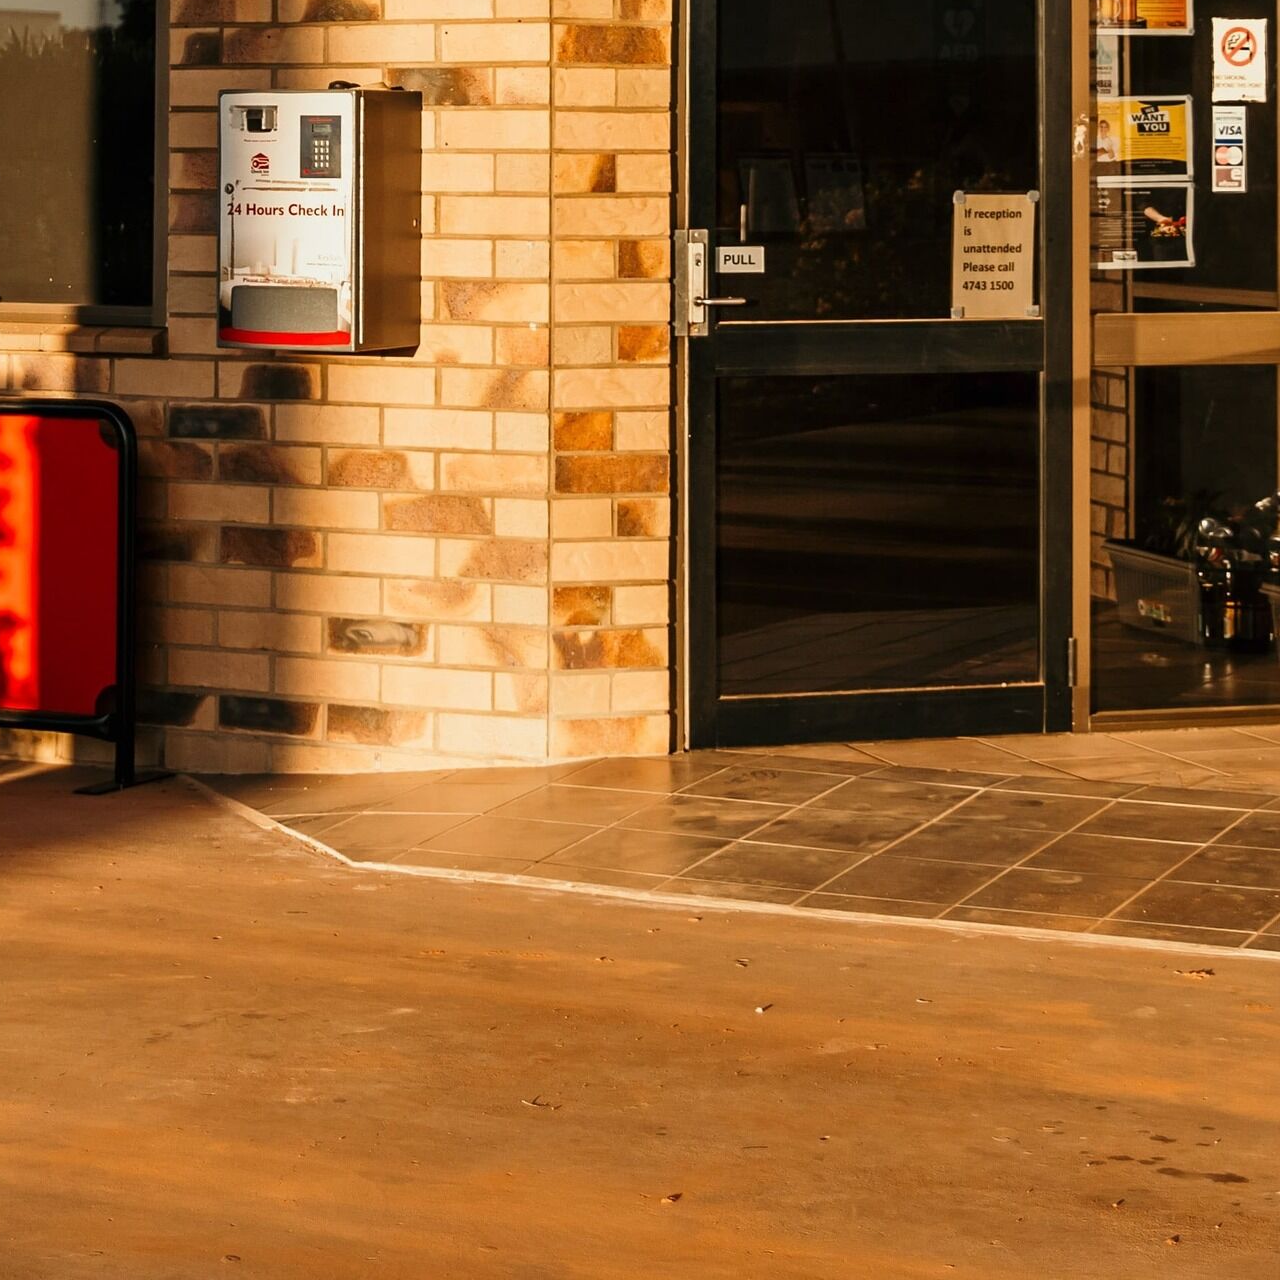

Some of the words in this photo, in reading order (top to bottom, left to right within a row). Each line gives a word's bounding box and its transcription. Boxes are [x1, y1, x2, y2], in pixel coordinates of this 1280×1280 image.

[1131, 114, 1165, 122] WANT
[1143, 123, 1167, 131] YOU
[1219, 125, 1242, 135] VISA
[227, 204, 242, 215] 24
[246, 203, 284, 216] Hours
[289, 204, 327, 216] Check
[333, 204, 345, 216] In
[964, 208, 972, 218] If
[974, 209, 1022, 220] reception
[963, 226, 972, 236] is
[963, 243, 1022, 253] unattended
[723, 254, 756, 265] PULL
[963, 262, 995, 272] Please
[998, 262, 1015, 272] call
[962, 281, 987, 290] 4743
[990, 280, 1014, 290] 1500
